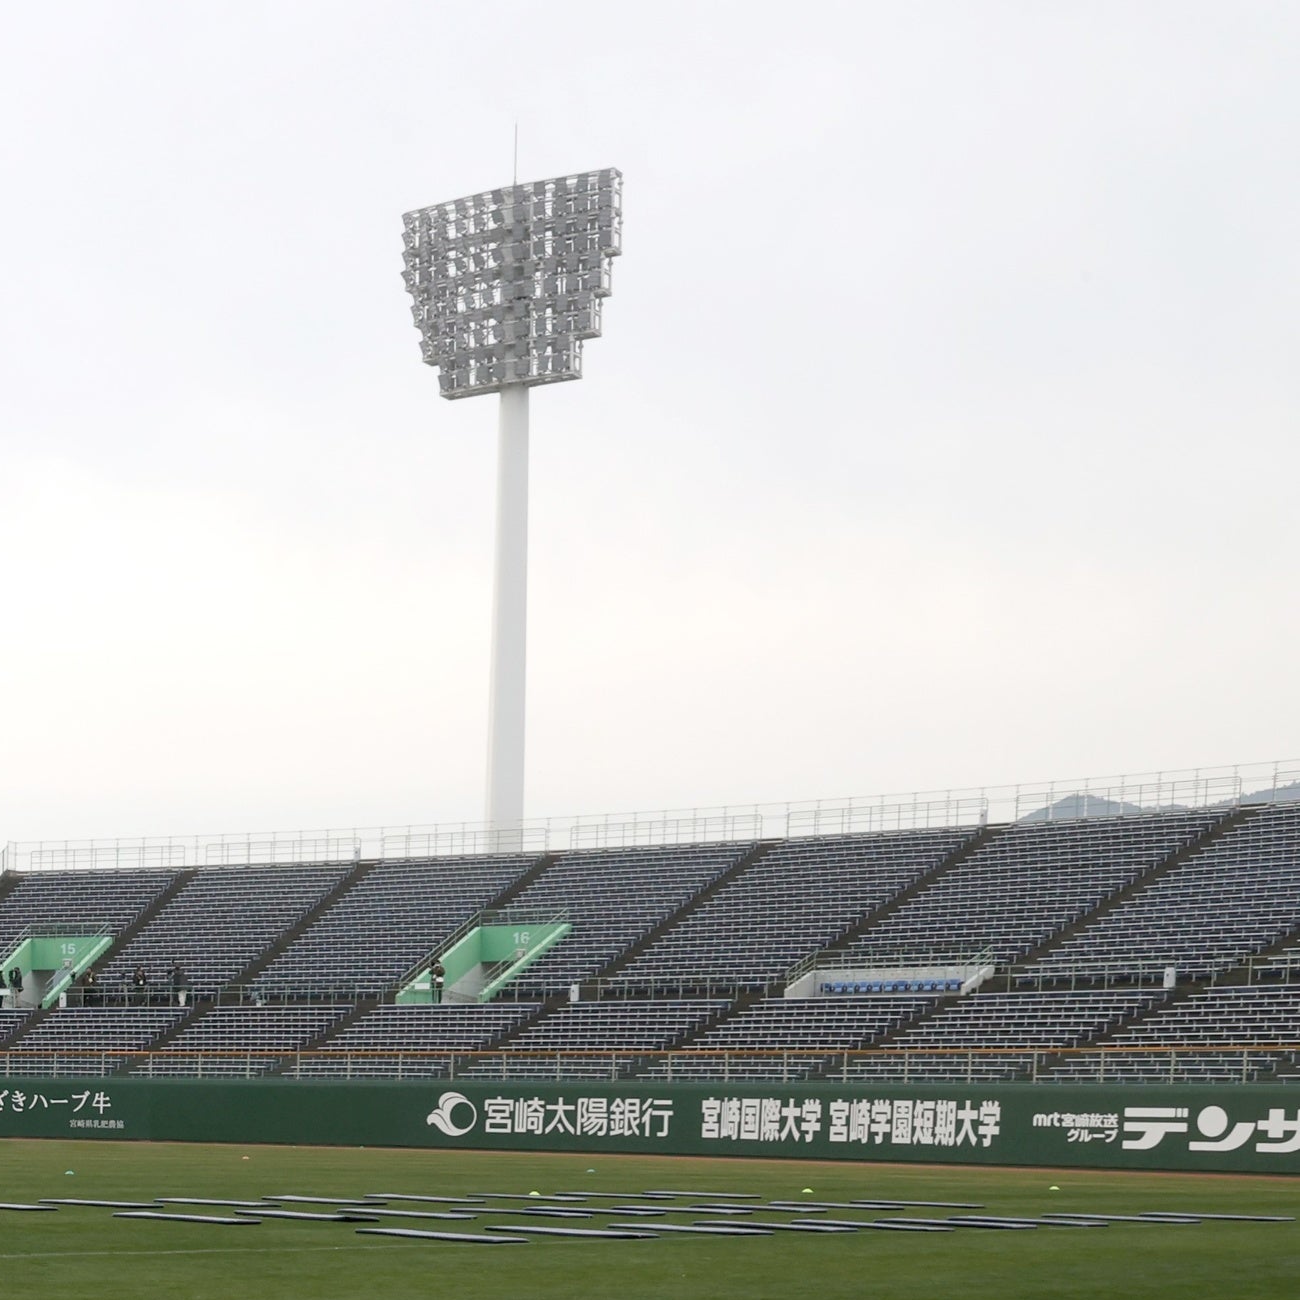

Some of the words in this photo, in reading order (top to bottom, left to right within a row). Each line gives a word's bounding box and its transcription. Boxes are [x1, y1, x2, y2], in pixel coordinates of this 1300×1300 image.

[512, 931, 530, 945] 16
[60, 943, 77, 955] 15
[484, 1096, 674, 1137] 宮崎太陽銀行
[701, 1097, 822, 1143] 宮崎国際大学
[829, 1098, 1001, 1147] 宮崎学園短期大学
[1067, 1129, 1118, 1143] グループ
